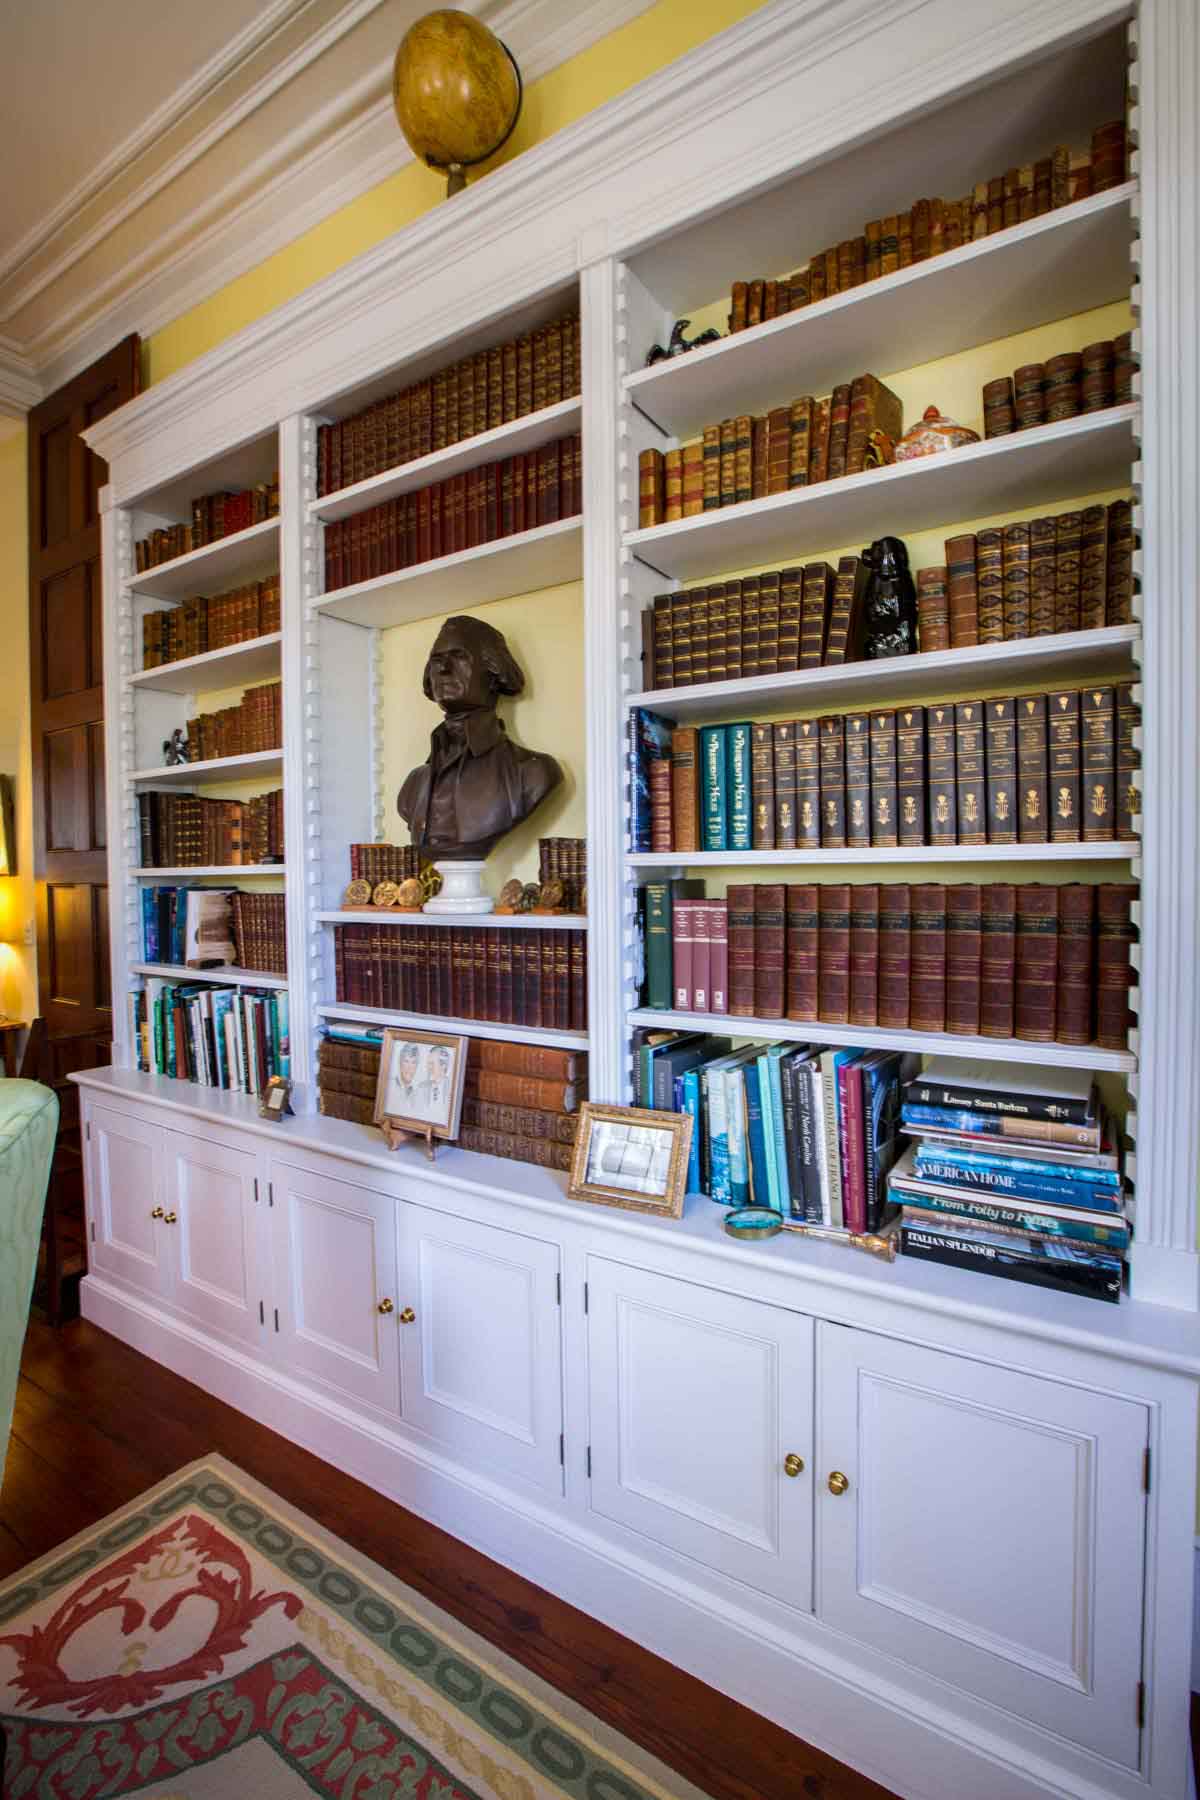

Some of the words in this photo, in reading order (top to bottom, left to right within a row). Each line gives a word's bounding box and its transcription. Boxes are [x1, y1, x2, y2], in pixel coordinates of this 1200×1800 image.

[920, 1162, 977, 1185] AMERICAN
[980, 1171, 1017, 1189] HOME
[932, 1197, 966, 1211] From
[1001, 1208, 1015, 1219] to
[907, 1232, 948, 1249] ITALIAN
[948, 1238, 996, 1258] SPLENDOR
